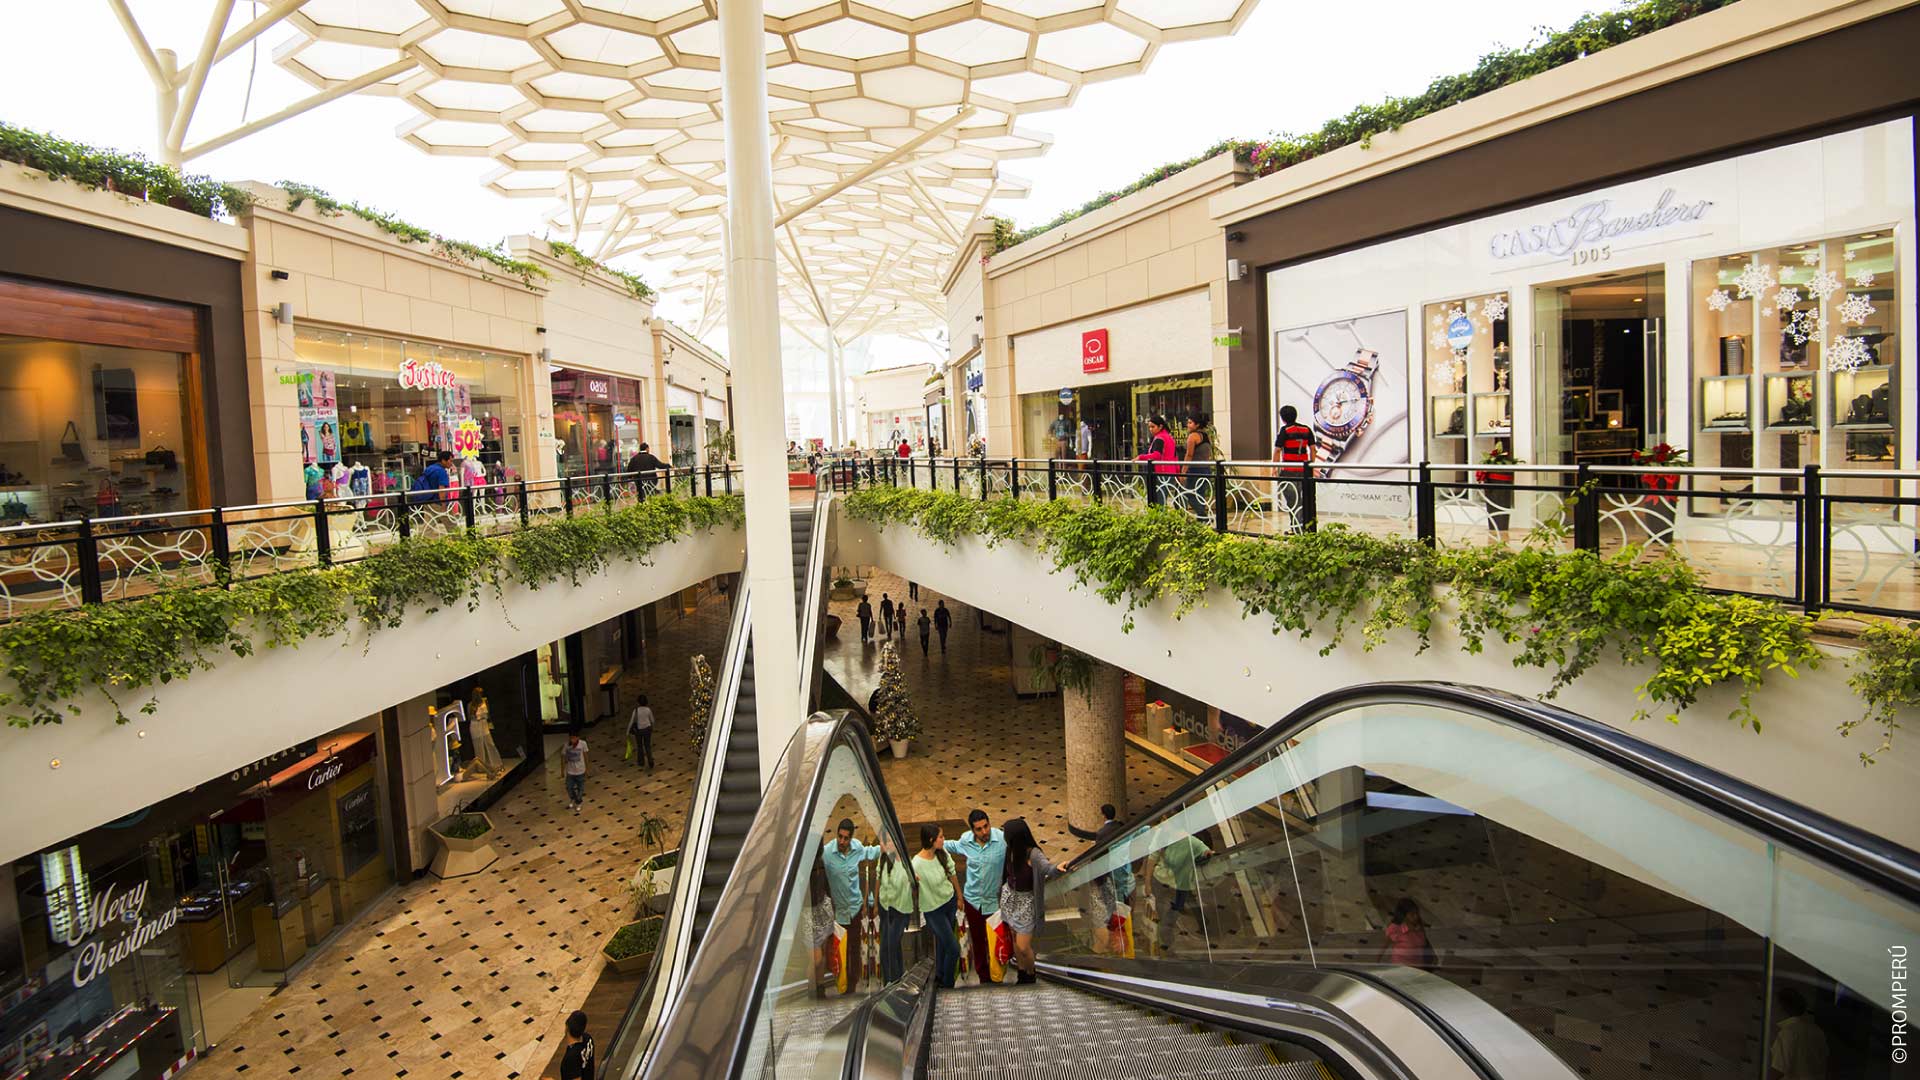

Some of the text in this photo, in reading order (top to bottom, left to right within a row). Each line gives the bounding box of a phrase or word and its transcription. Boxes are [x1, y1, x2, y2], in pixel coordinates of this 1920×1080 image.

[1491, 224, 1565, 259] CASA
[1571, 245, 1612, 266] 1905
[406, 361, 455, 388] Justice
[1083, 355, 1105, 366] OSCAR
[1171, 709, 1210, 741] didas
[308, 762, 344, 790] Cartier
[67, 880, 148, 947] Merry
[73, 906, 177, 988] Christmas
